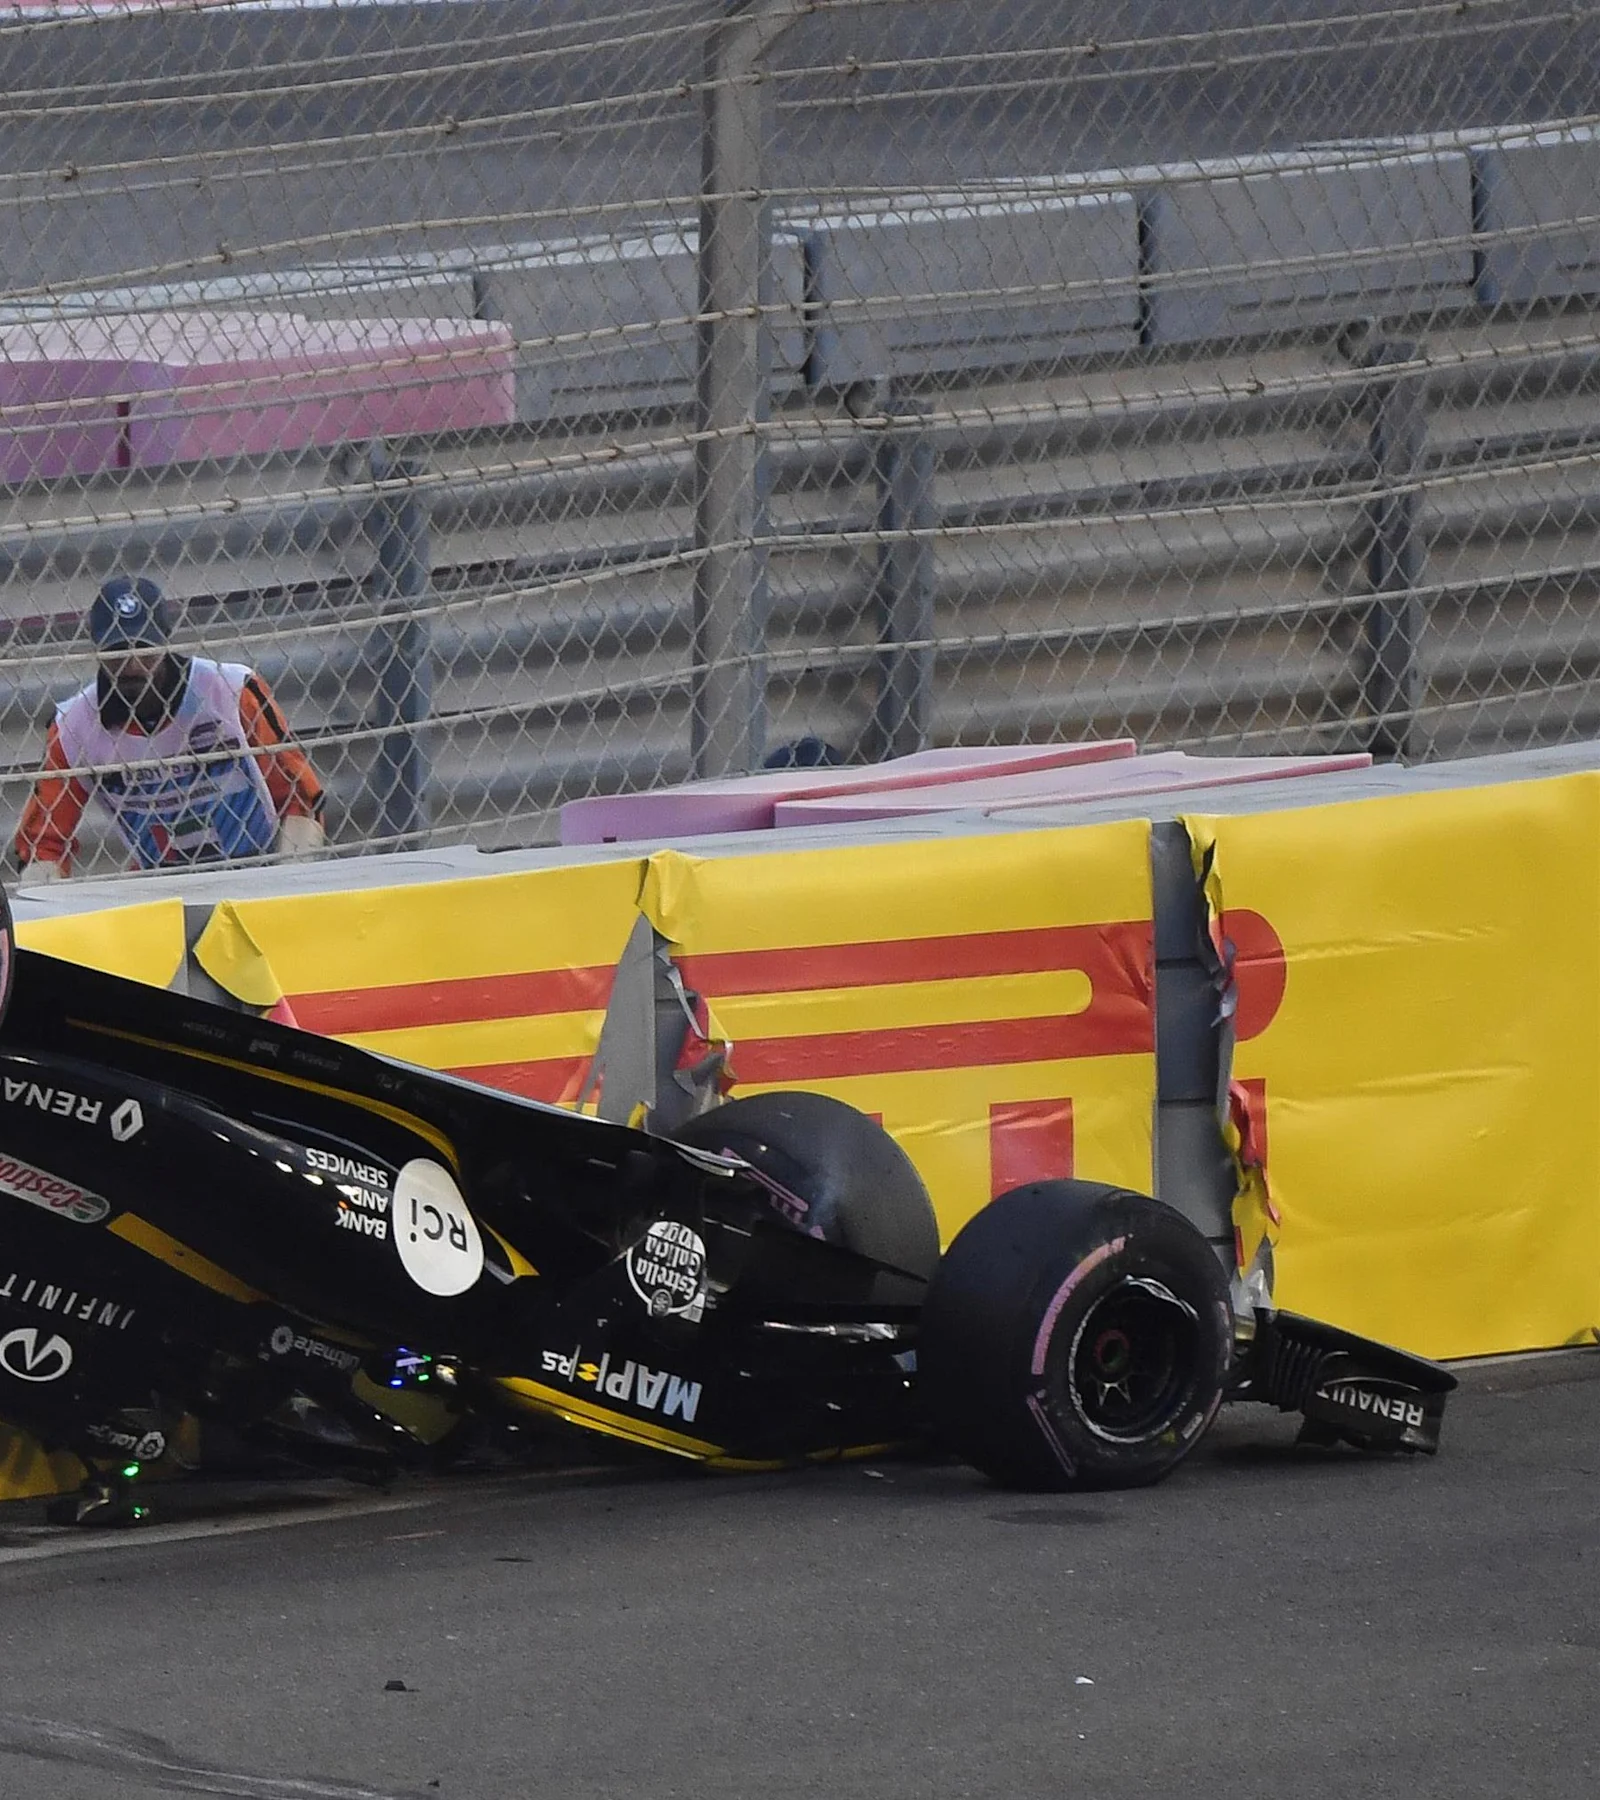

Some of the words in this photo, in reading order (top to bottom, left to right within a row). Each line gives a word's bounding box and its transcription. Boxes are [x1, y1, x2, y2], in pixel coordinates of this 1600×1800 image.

[305, 1148, 389, 1188] SERVICES
[350, 1185, 389, 1213] AND
[335, 1206, 388, 1240] BANK
[644, 1234, 701, 1277] Galicia
[636, 1257, 699, 1301] Estrella
